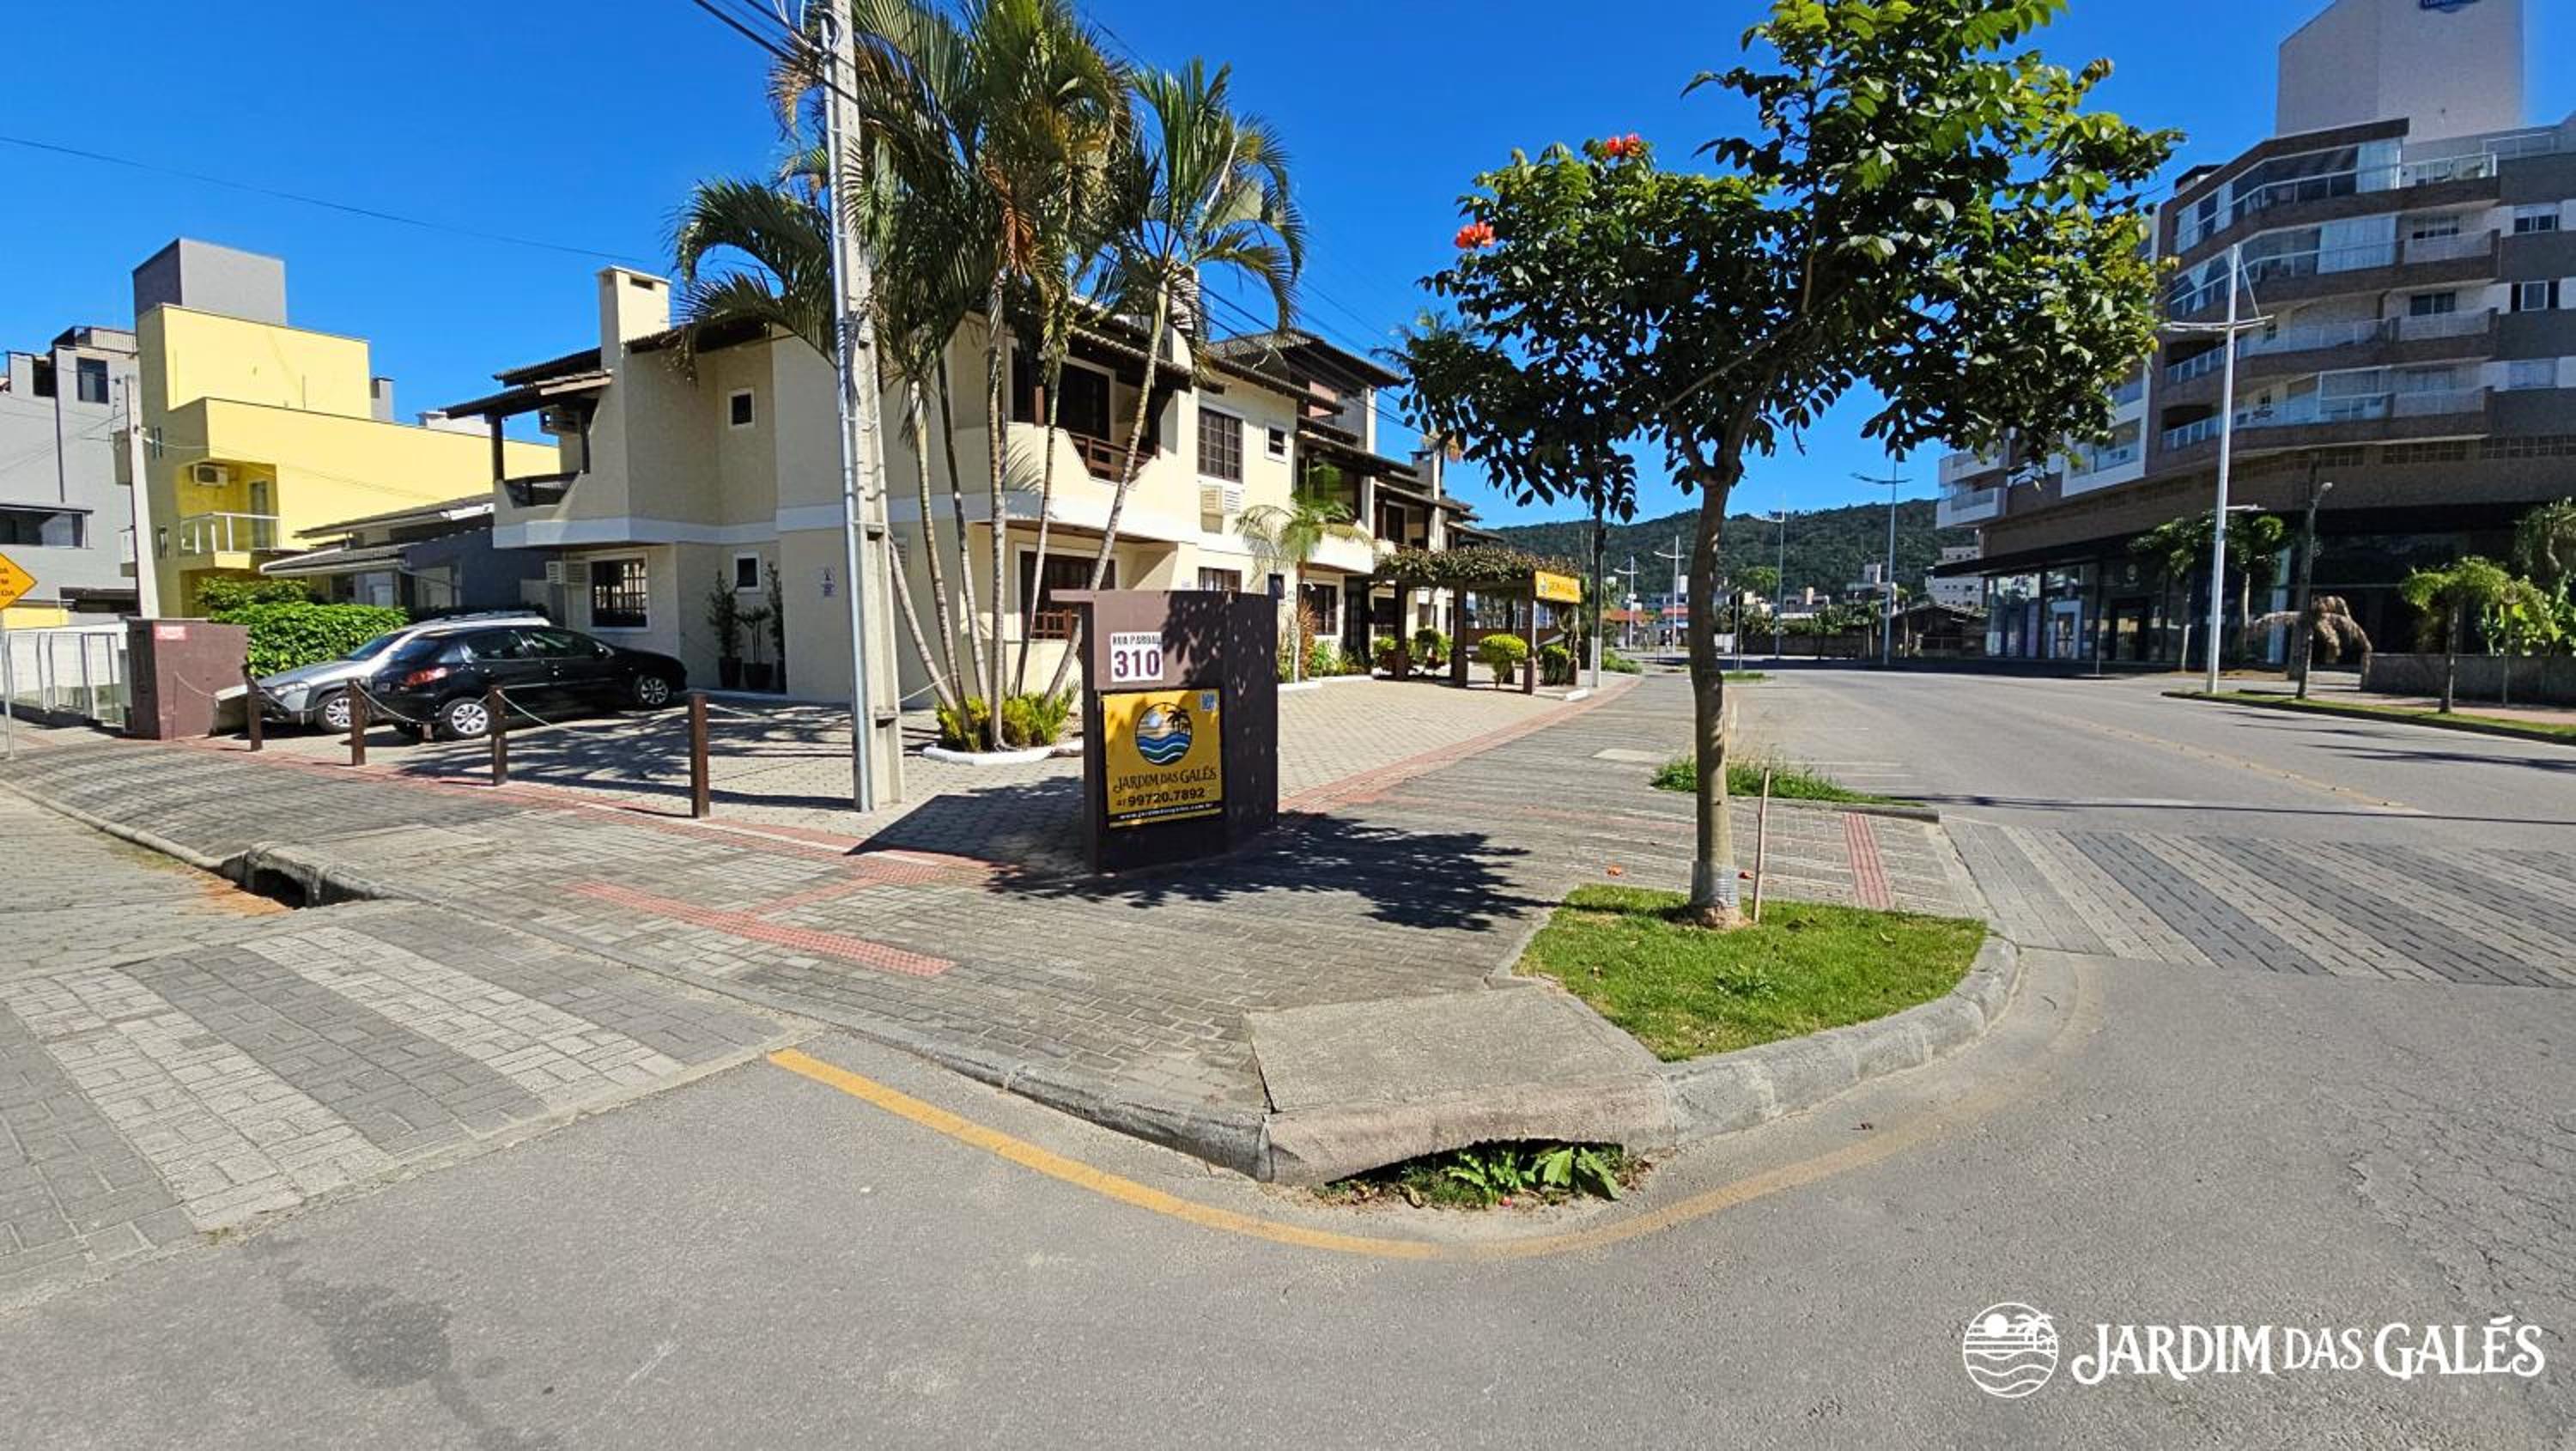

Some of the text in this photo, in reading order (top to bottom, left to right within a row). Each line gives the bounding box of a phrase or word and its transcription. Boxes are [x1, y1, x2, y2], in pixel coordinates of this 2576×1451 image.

[1114, 649, 1160, 678] 310
[1113, 765, 1218, 793] JARDIM DAS GALÉS
[1127, 787, 1206, 807] 99720.7892
